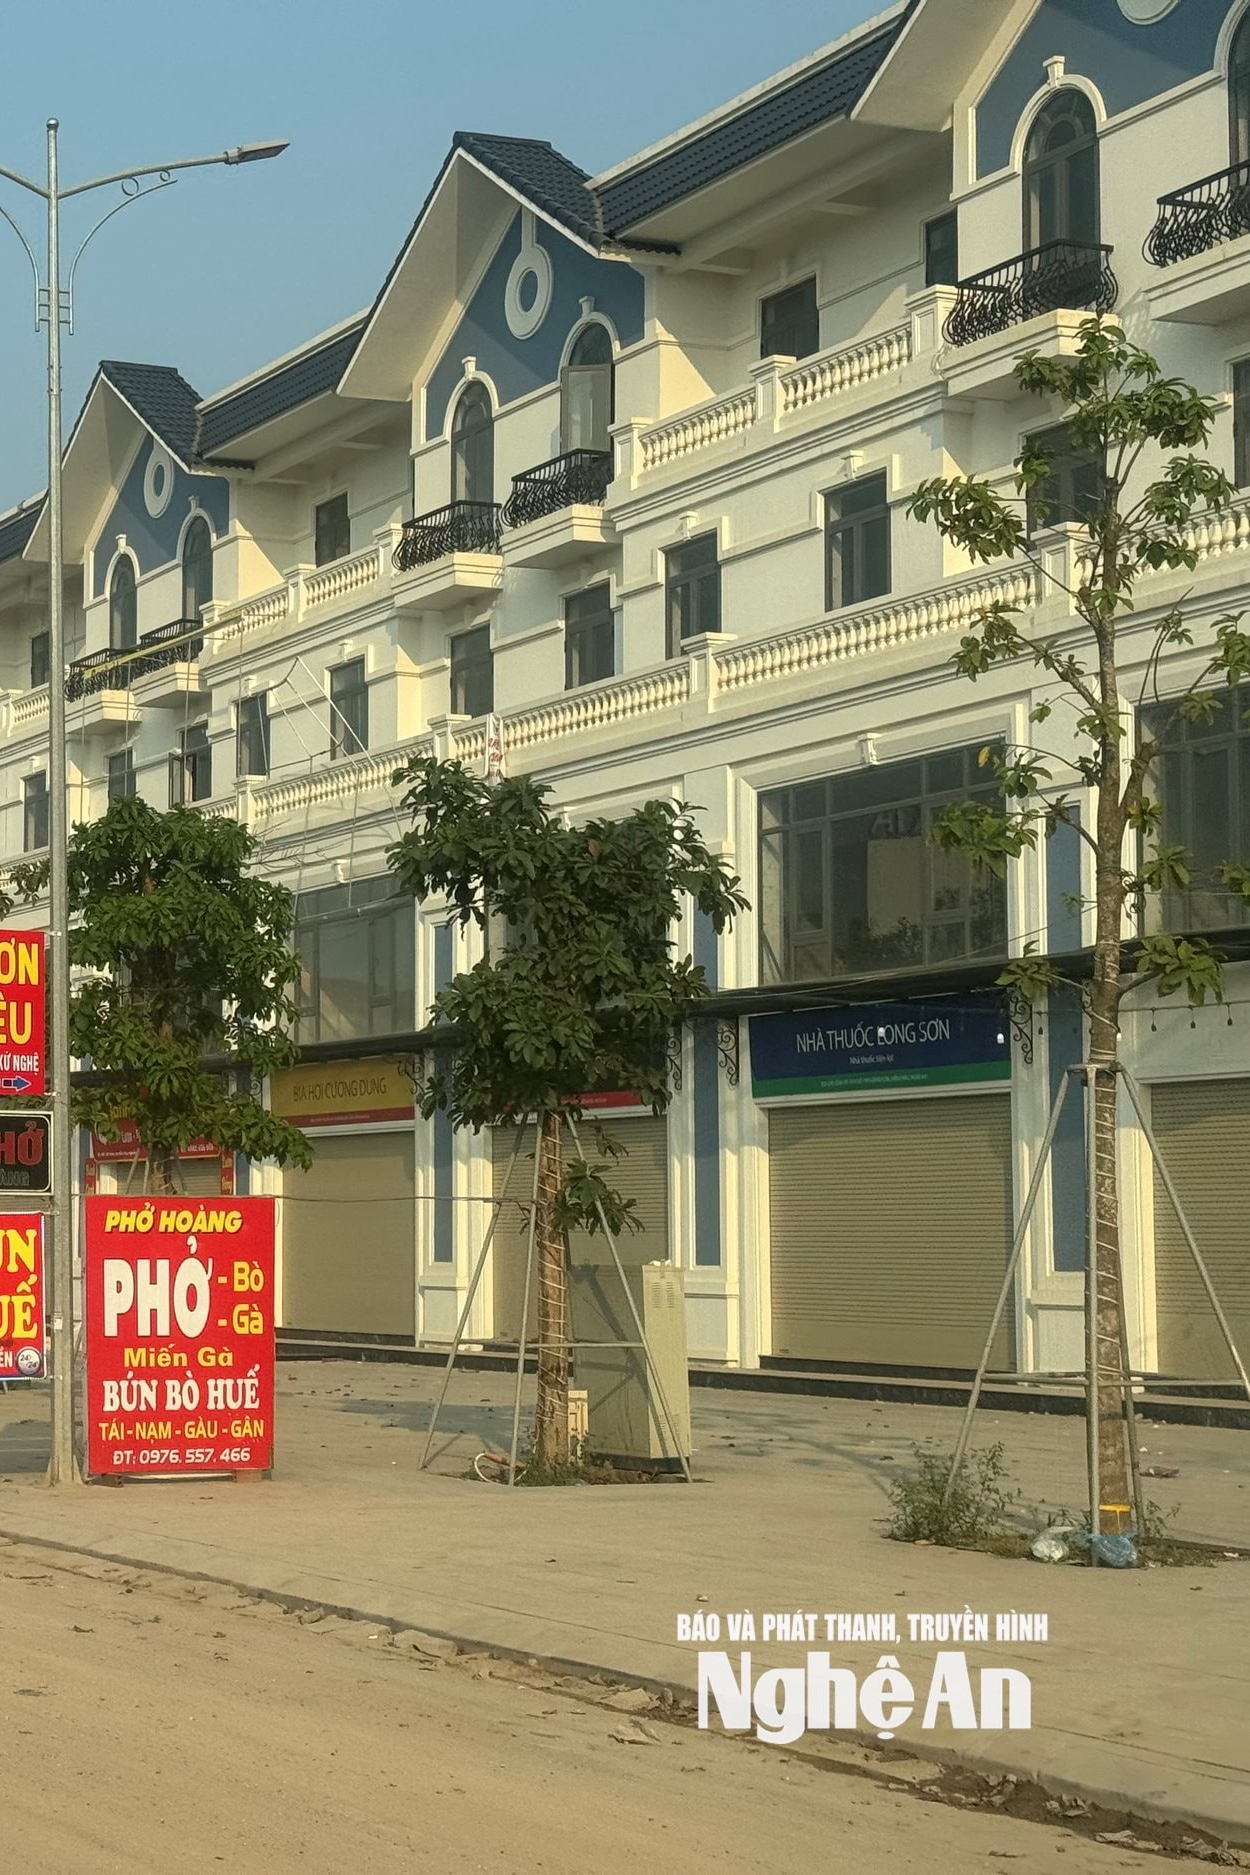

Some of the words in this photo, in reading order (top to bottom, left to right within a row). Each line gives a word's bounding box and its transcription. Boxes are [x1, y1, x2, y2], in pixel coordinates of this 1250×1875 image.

[796, 1029, 826, 1053] NHÀ
[827, 1021, 874, 1049] THUỐC
[919, 1018, 950, 1042] SƠN
[13, 1052, 39, 1075] NGHỆ
[105, 1202, 156, 1233] PHỞ
[159, 1205, 243, 1233] HOÀNG
[103, 1234, 214, 1338] PHỞ
[234, 1261, 264, 1292] Bò
[232, 1304, 264, 1334] Gà
[124, 1344, 188, 1368] Miến
[198, 1346, 233, 1368] Gà
[103, 1371, 158, 1412] BÚN
[165, 1370, 200, 1412] BÒ
[207, 1364, 260, 1410] HUẾ
[99, 1418, 124, 1440] TÁI
[136, 1422, 172, 1444] NẠM
[185, 1416, 218, 1438] GÀU
[113, 1450, 136, 1465] ĐT:
[220, 1448, 250, 1462] 466
